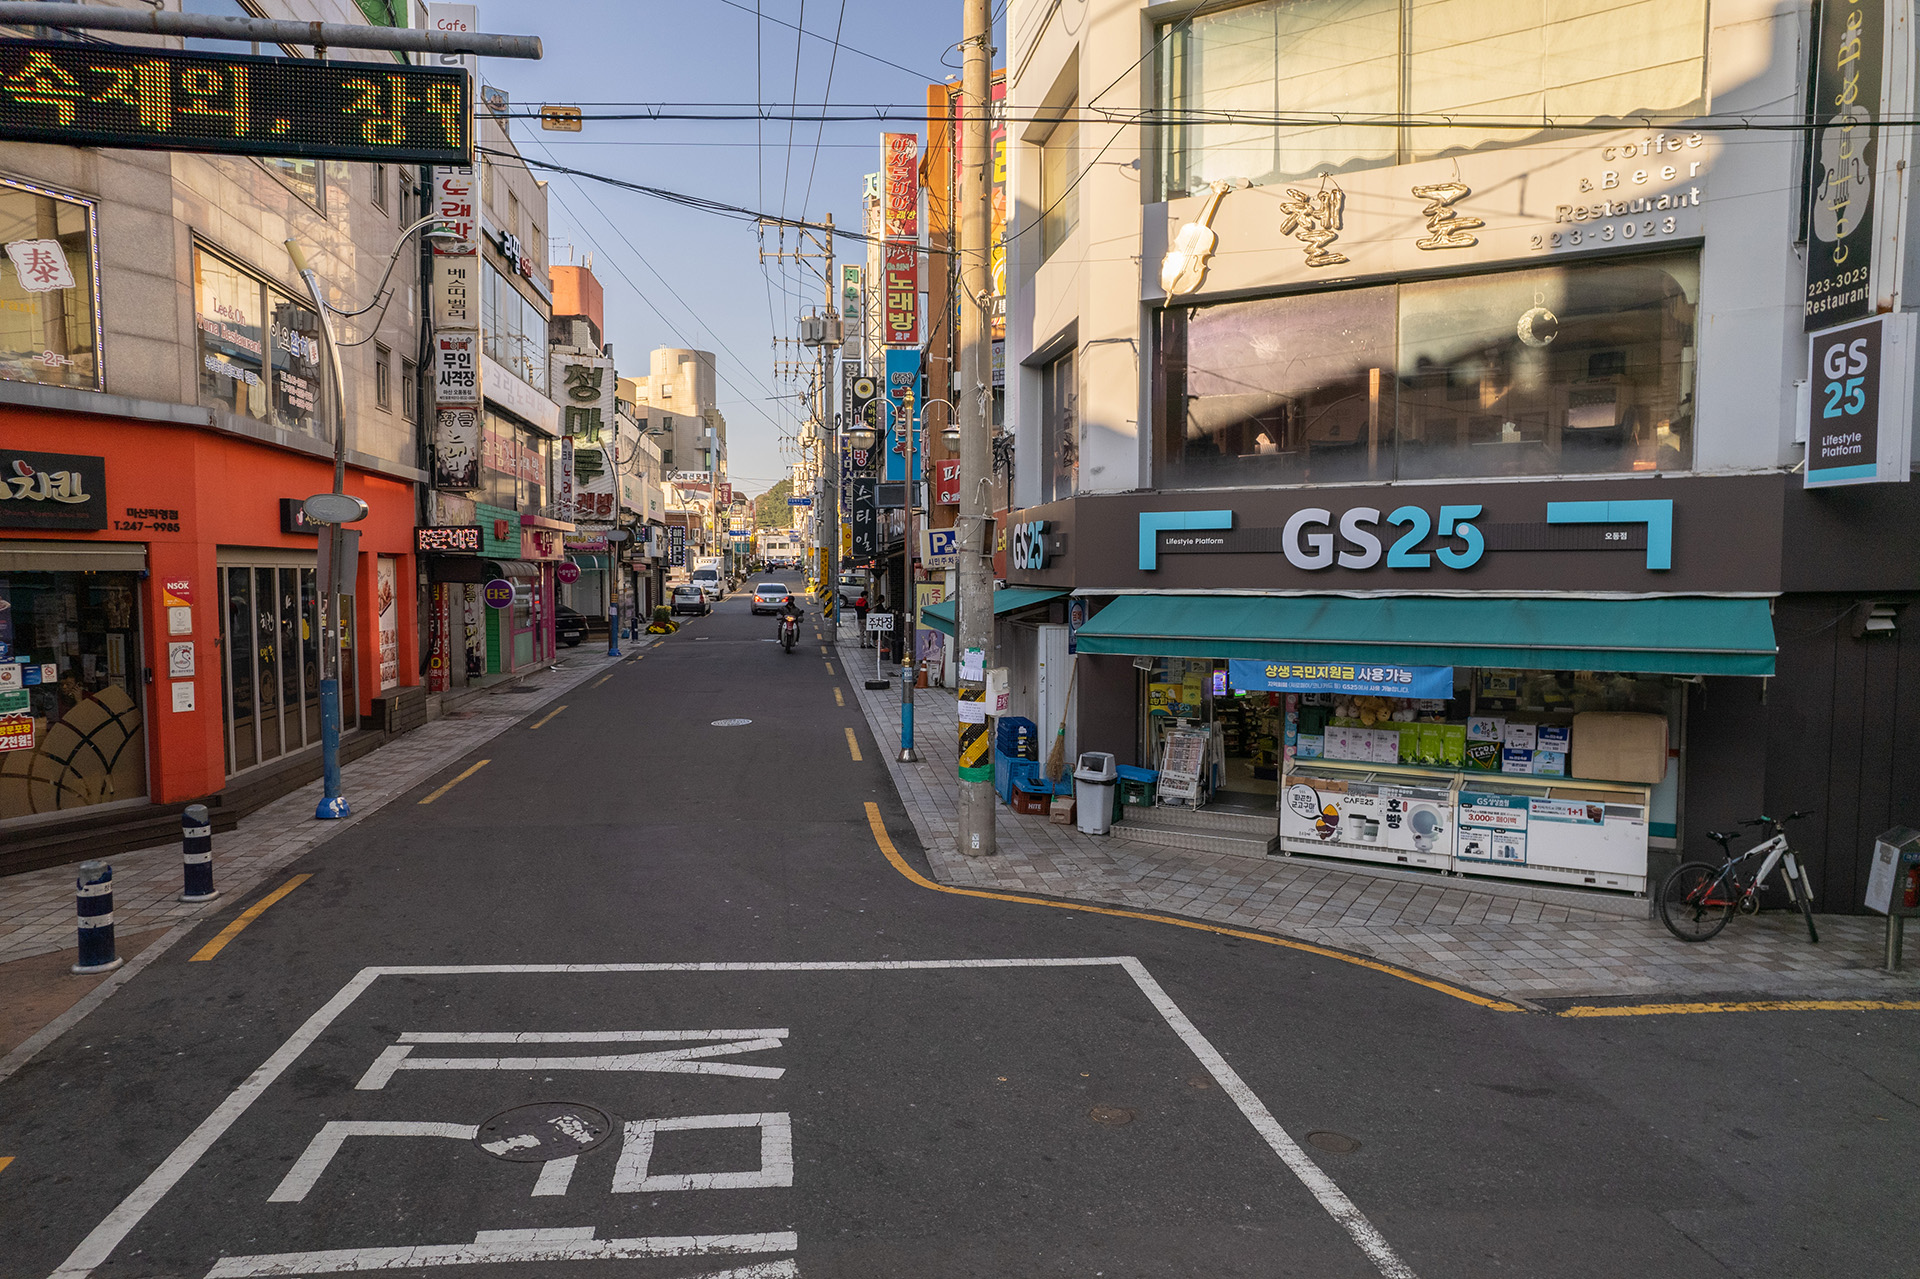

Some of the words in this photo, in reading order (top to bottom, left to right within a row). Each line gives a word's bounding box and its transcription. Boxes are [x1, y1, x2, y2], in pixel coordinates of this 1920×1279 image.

[437, 18, 467, 32] Cafe
[1837, 0, 1863, 71] Be
[1602, 132, 1703, 161] coffee
[890, 137, 911, 210] 아사루비아
[1579, 177, 1593, 193] &
[1601, 161, 1701, 190] Beer
[885, 210, 917, 221] 노래방
[1555, 187, 1701, 224] Restaurant
[1530, 215, 1677, 250] 223-3023
[23, 248, 60, 284] 泰
[447, 268, 466, 320] 베스띠벨리
[844, 268, 859, 318] 제우스
[1808, 266, 1868, 297] 223-3023
[887, 272, 917, 331] 노래방
[1805, 283, 1870, 317] Restaurant
[196, 312, 219, 336] Tuna
[220, 322, 262, 354] Restaurant
[895, 331, 910, 340] 2F
[443, 352, 471, 369] 무인
[1823, 337, 1868, 380] GS
[440, 371, 475, 387] 사격장
[1823, 375, 1866, 419] 25
[440, 411, 475, 427] 황금
[564, 363, 605, 486] 청마루
[1821, 443, 1862, 458] Platform
[1822, 432, 1863, 448] Lifestyle
[114, 520, 180, 533] T.247-9985
[126, 507, 179, 520] 마산직영점
[856, 484, 872, 552] 스타일
[932, 532, 947, 553] P
[1013, 520, 1044, 570] GS25
[1166, 538, 1194, 546] Lifestyle
[1281, 504, 1485, 570] GS25
[167, 582, 190, 590] NSOK
[486, 588, 510, 600] 타로
[868, 616, 893, 629] 주차장
[1265, 664, 1290, 678] 상생
[1291, 665, 1355, 681] 국민지원금
[1358, 667, 1384, 682] 사용
[1385, 668, 1413, 683] 가능
[1343, 796, 1374, 806] CAFE25
[1387, 798, 1402, 829] 호빵
[1567, 807, 1583, 817] 1+1
